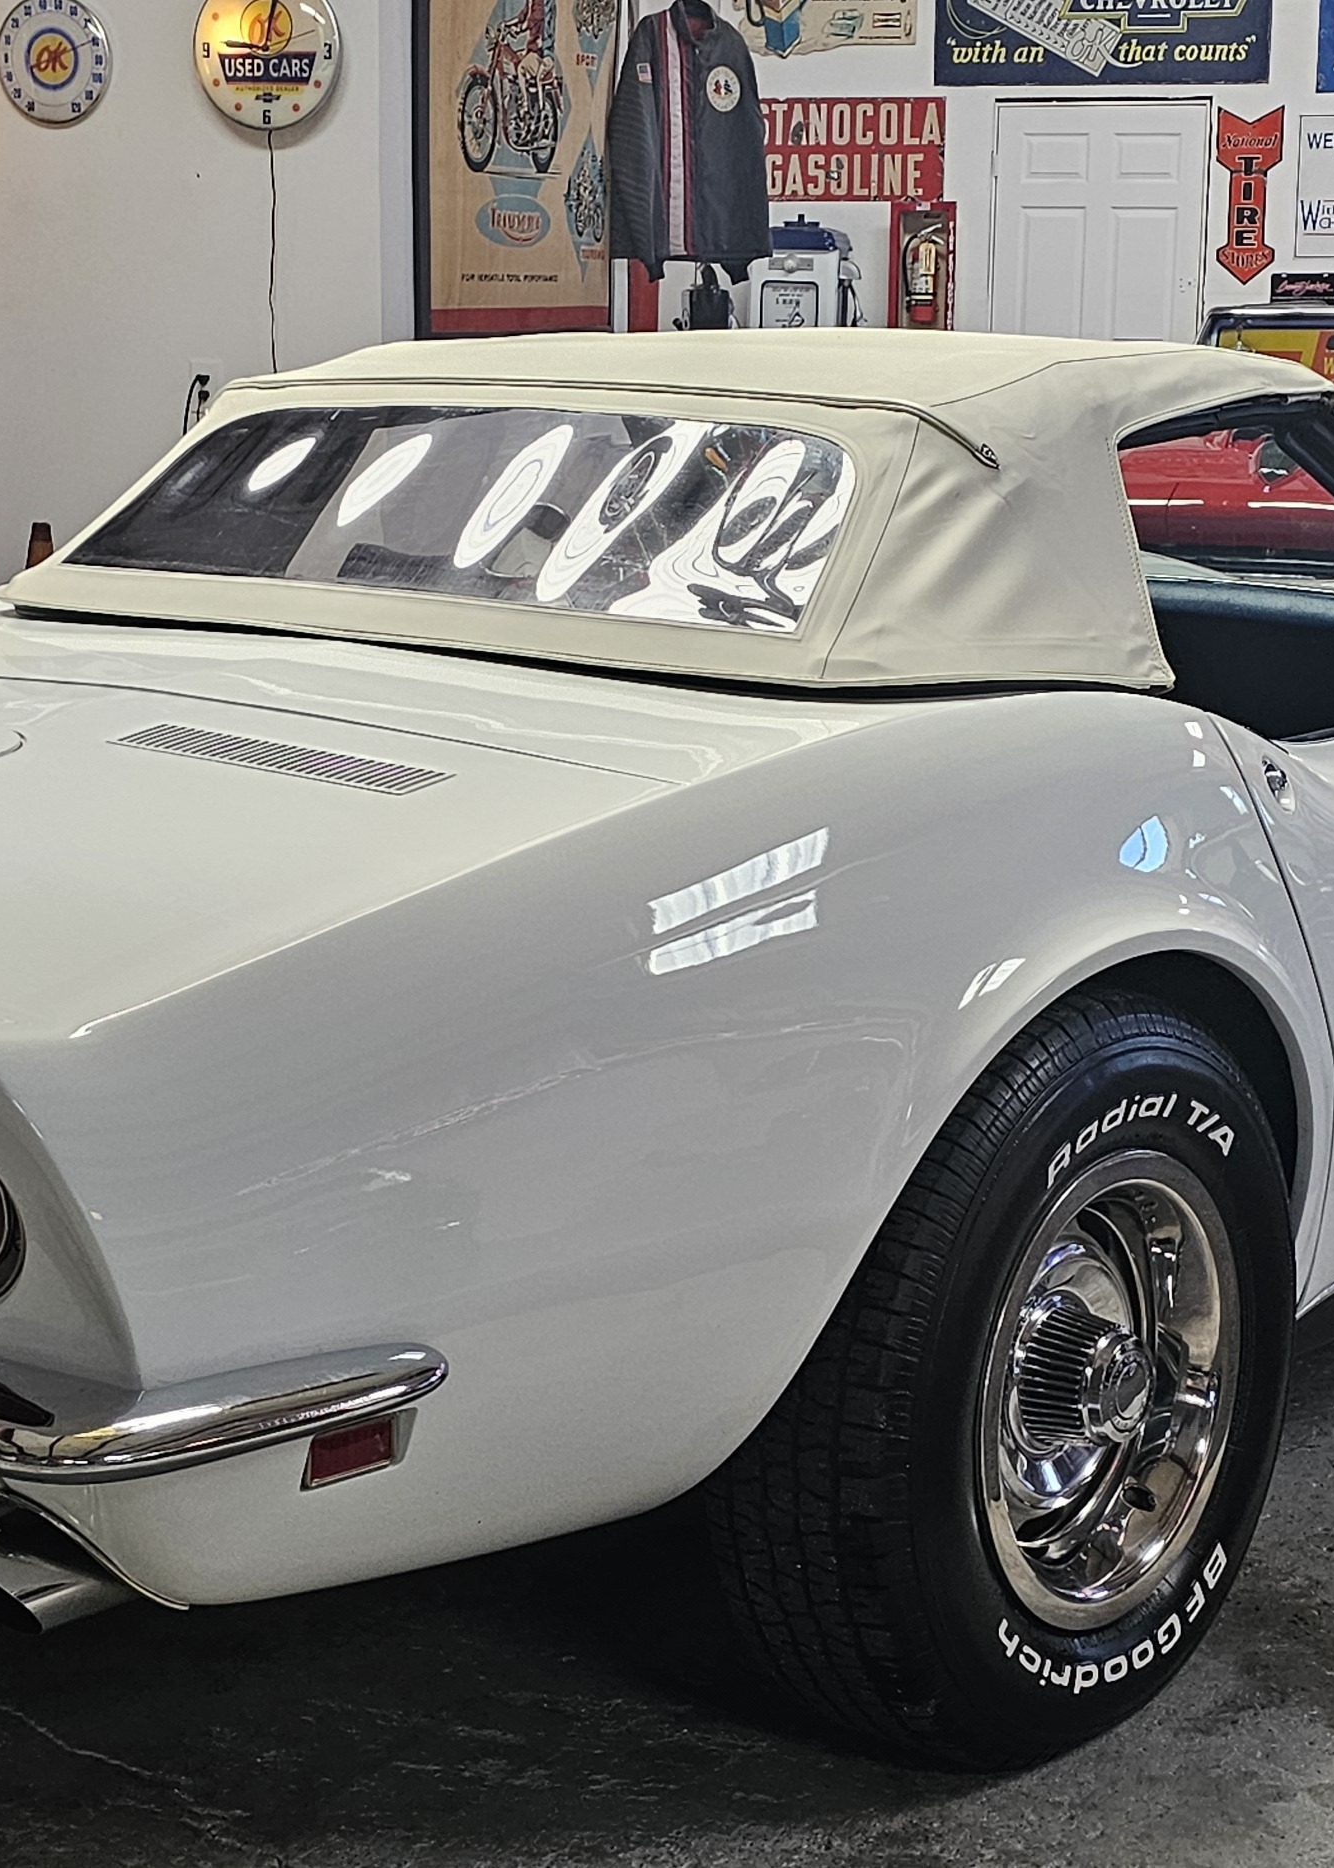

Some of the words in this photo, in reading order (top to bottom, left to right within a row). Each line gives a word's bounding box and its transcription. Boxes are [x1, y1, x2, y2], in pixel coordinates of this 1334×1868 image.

[35, 41, 69, 73] OK
[202, 42, 210, 58] 9
[324, 43, 332, 60] 3
[1013, 46, 1045, 63] an
[1119, 40, 1168, 63] that
[224, 58, 264, 77] USED
[269, 58, 310, 77] CARS
[263, 109, 271, 125] 6
[1223, 134, 1277, 147] National
[766, 153, 924, 196] GASOLINE
[1234, 155, 1262, 247] TIRE
[1222, 251, 1269, 269] STORES
[1046, 1093, 1178, 1189] Radial
[1186, 1100, 1235, 1157] T/A
[998, 1541, 1227, 1694] BFGoodrich
